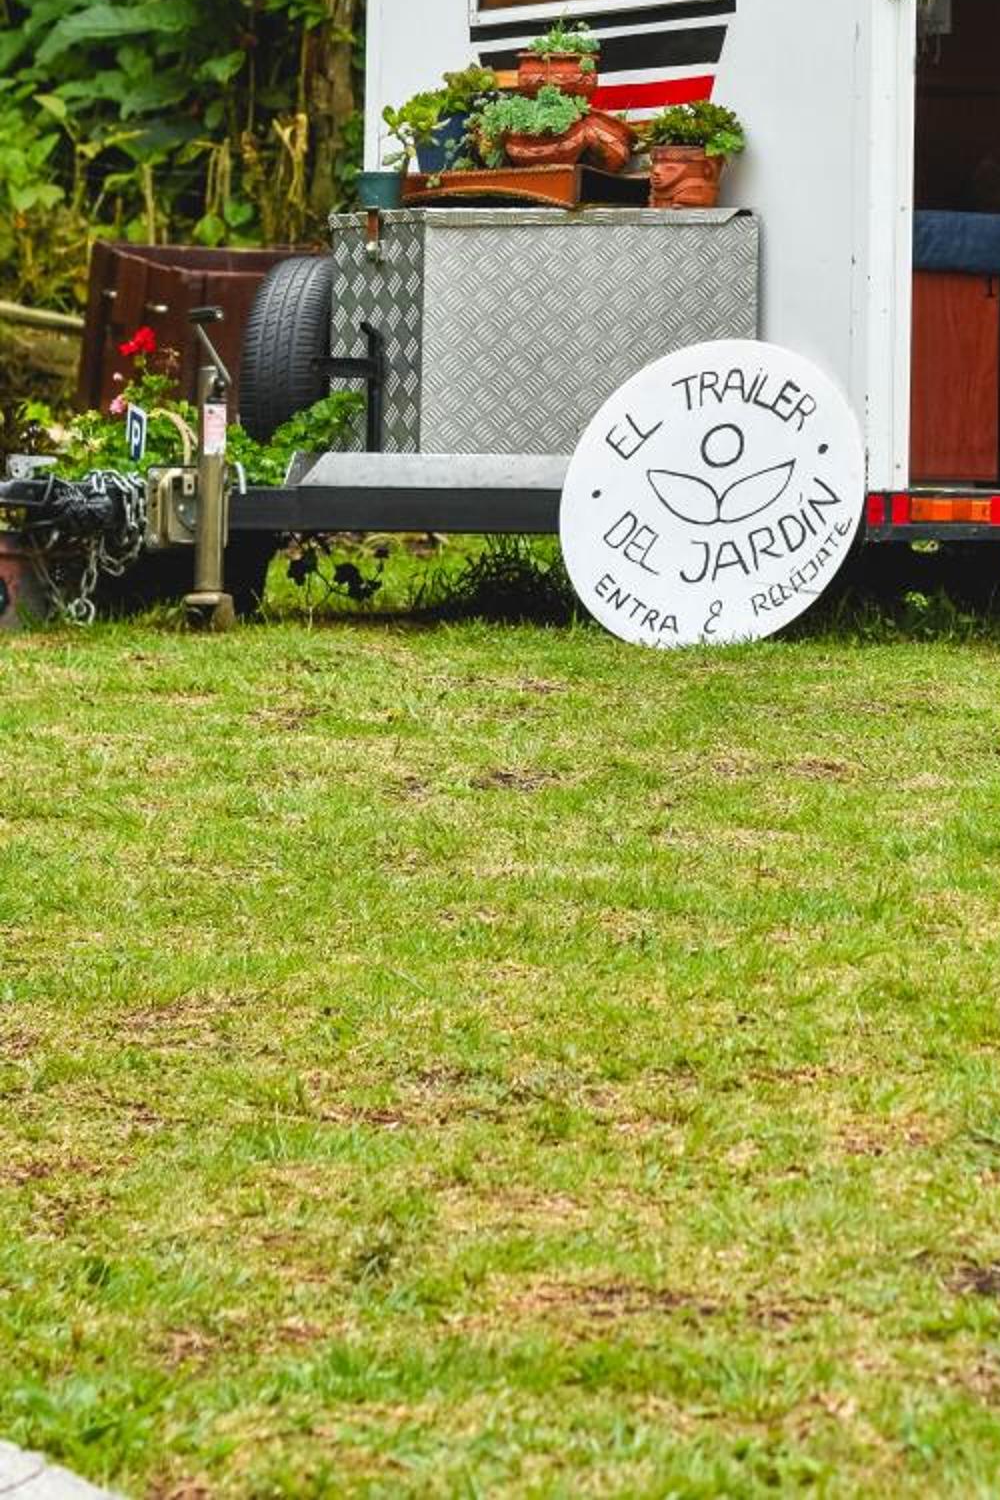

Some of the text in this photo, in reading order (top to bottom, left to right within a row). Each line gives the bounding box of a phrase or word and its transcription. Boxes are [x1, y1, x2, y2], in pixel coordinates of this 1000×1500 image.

[605, 413, 664, 461] EL
[603, 510, 660, 576] DEL
[594, 573, 679, 634] ENTRA
